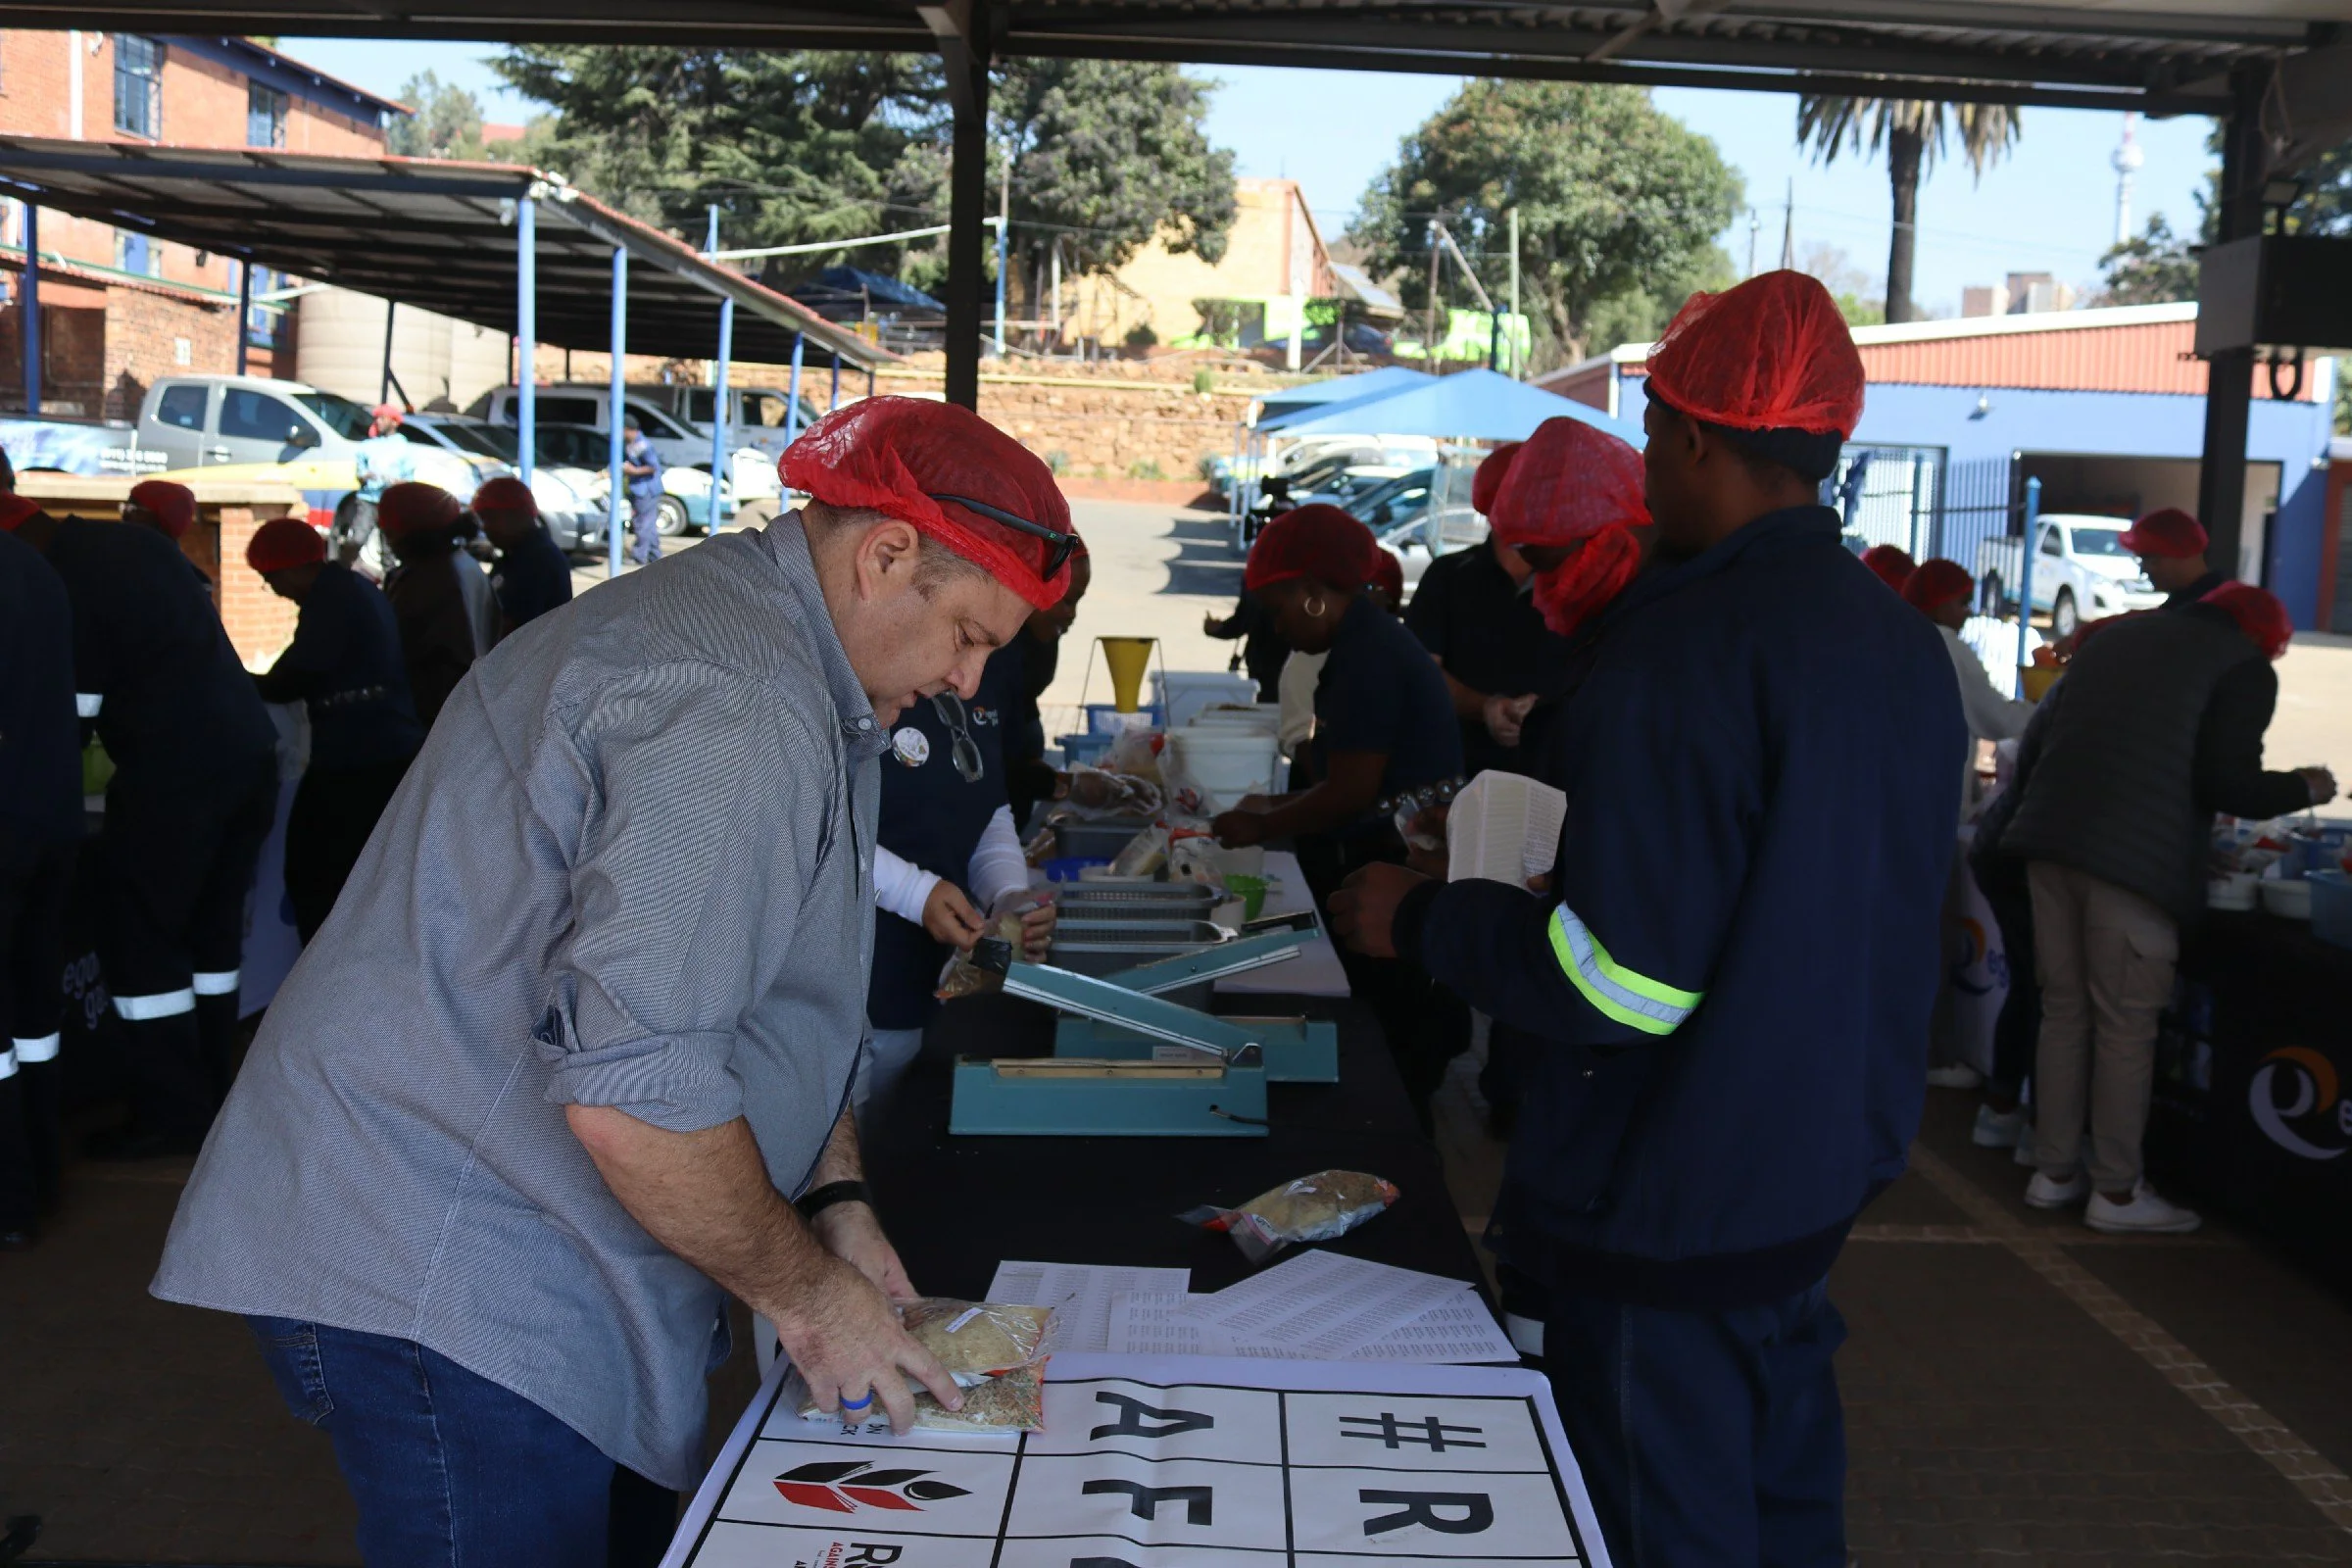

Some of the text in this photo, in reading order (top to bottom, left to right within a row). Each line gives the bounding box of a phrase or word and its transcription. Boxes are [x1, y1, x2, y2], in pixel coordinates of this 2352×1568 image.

[1090, 1391, 1214, 1442] A
[1082, 1479, 1212, 1527] F
[1359, 1489, 1494, 1537] R
